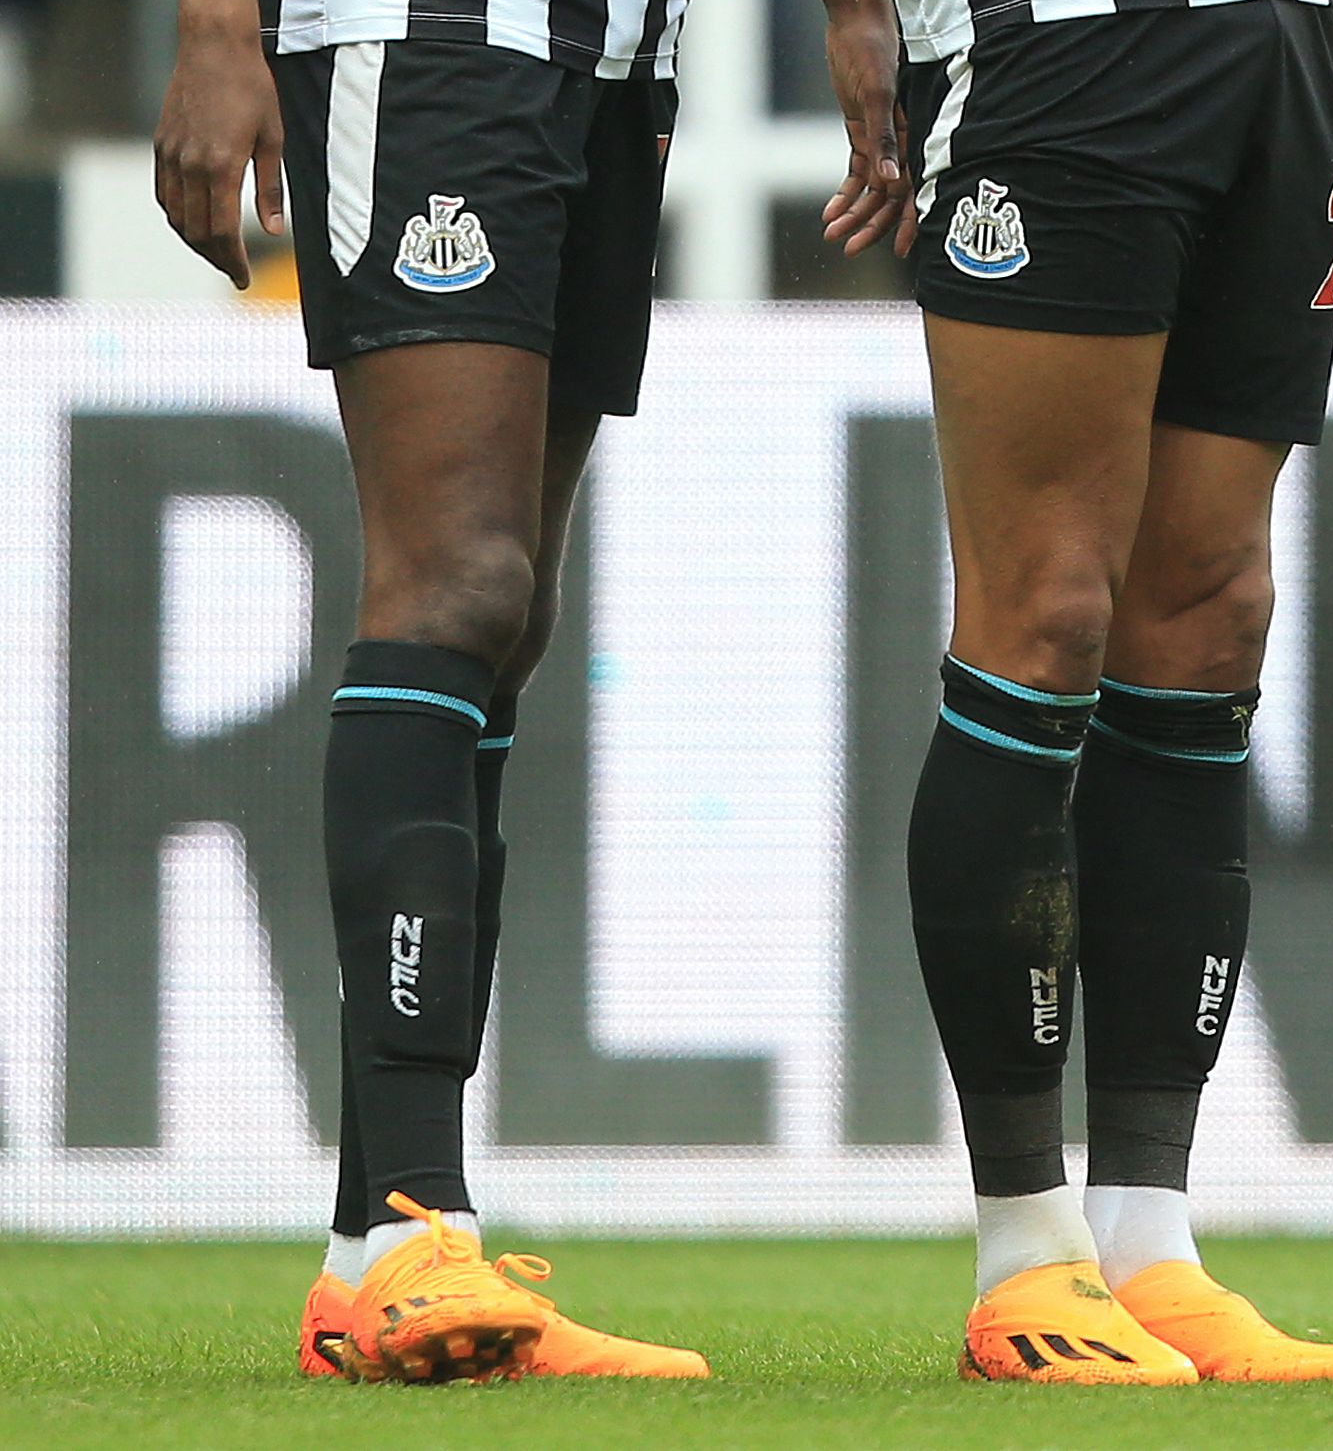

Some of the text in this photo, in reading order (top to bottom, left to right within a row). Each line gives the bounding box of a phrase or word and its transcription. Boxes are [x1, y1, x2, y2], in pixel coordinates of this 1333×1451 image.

[388, 913, 425, 1017] NUFC
[1029, 966, 1060, 1045] NUFC
[1195, 954, 1231, 1036] NUFC
